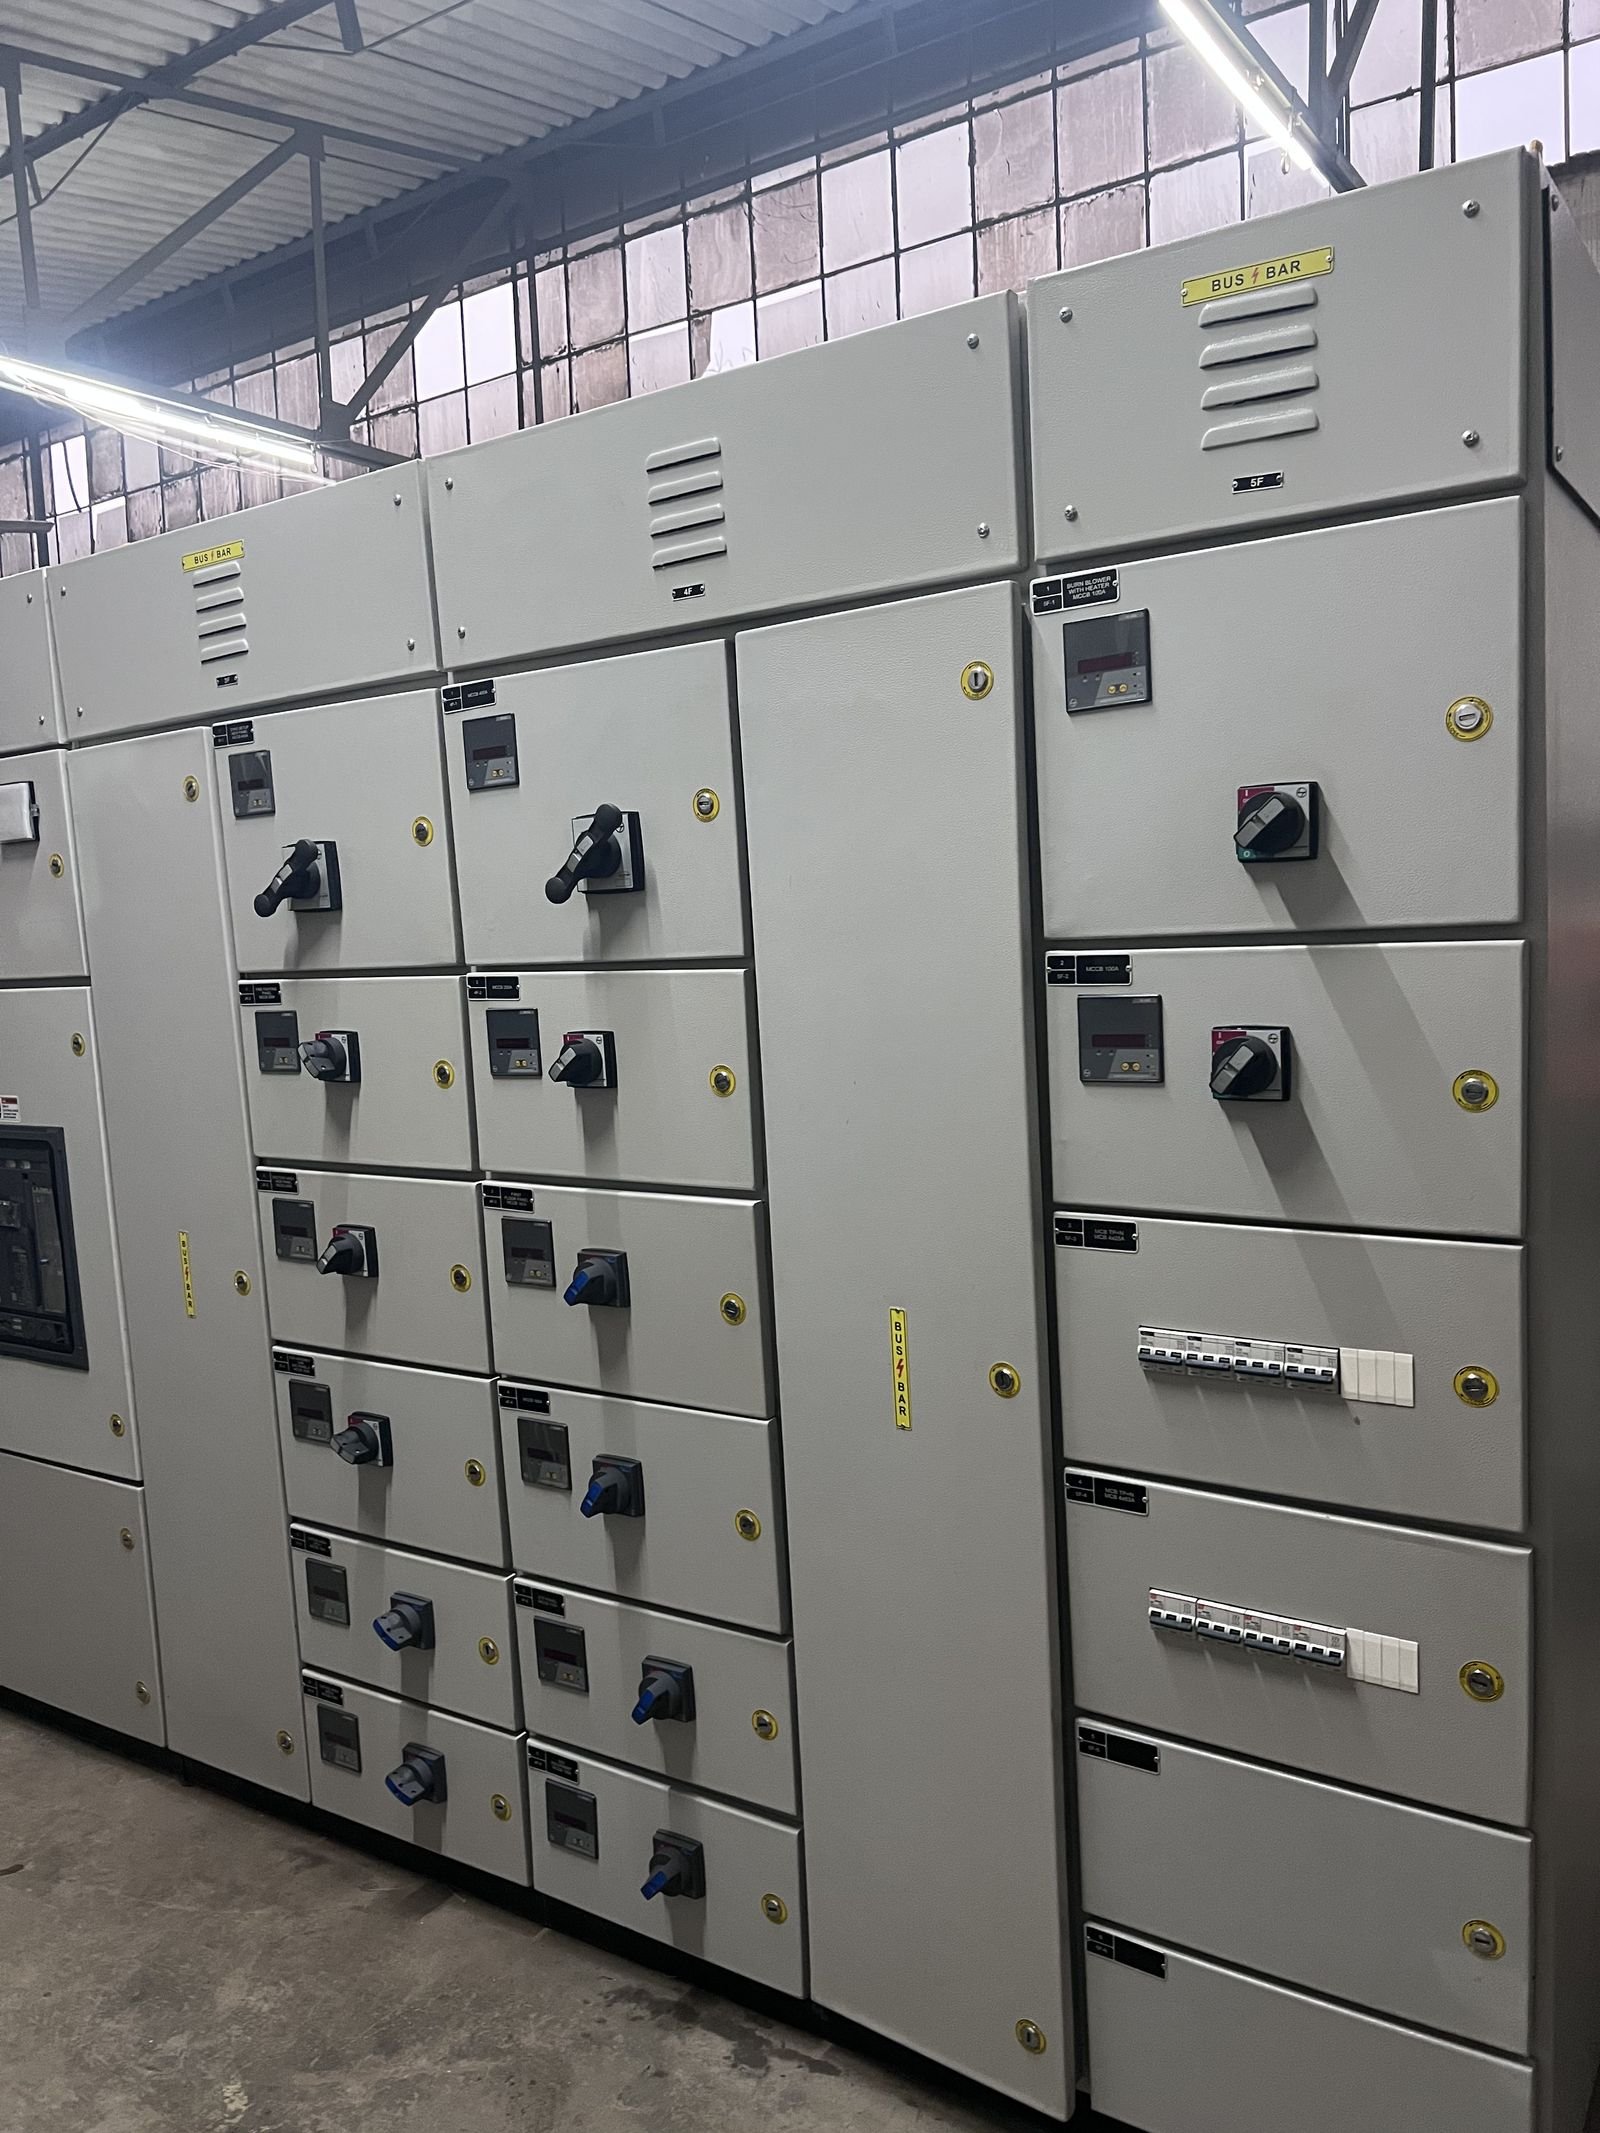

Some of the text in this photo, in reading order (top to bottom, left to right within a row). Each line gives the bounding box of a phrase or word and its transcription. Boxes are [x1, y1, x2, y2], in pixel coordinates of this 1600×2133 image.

[1211, 260, 1301, 292] BUS BAR
[1250, 477, 1265, 488] 5F
[194, 547, 232, 565] BUS BAR
[1085, 576, 1112, 586] BLOWER
[683, 587, 693, 596] 4F
[1068, 582, 1110, 596] WITH HEATER
[894, 1321, 907, 1416] BUS BAR
